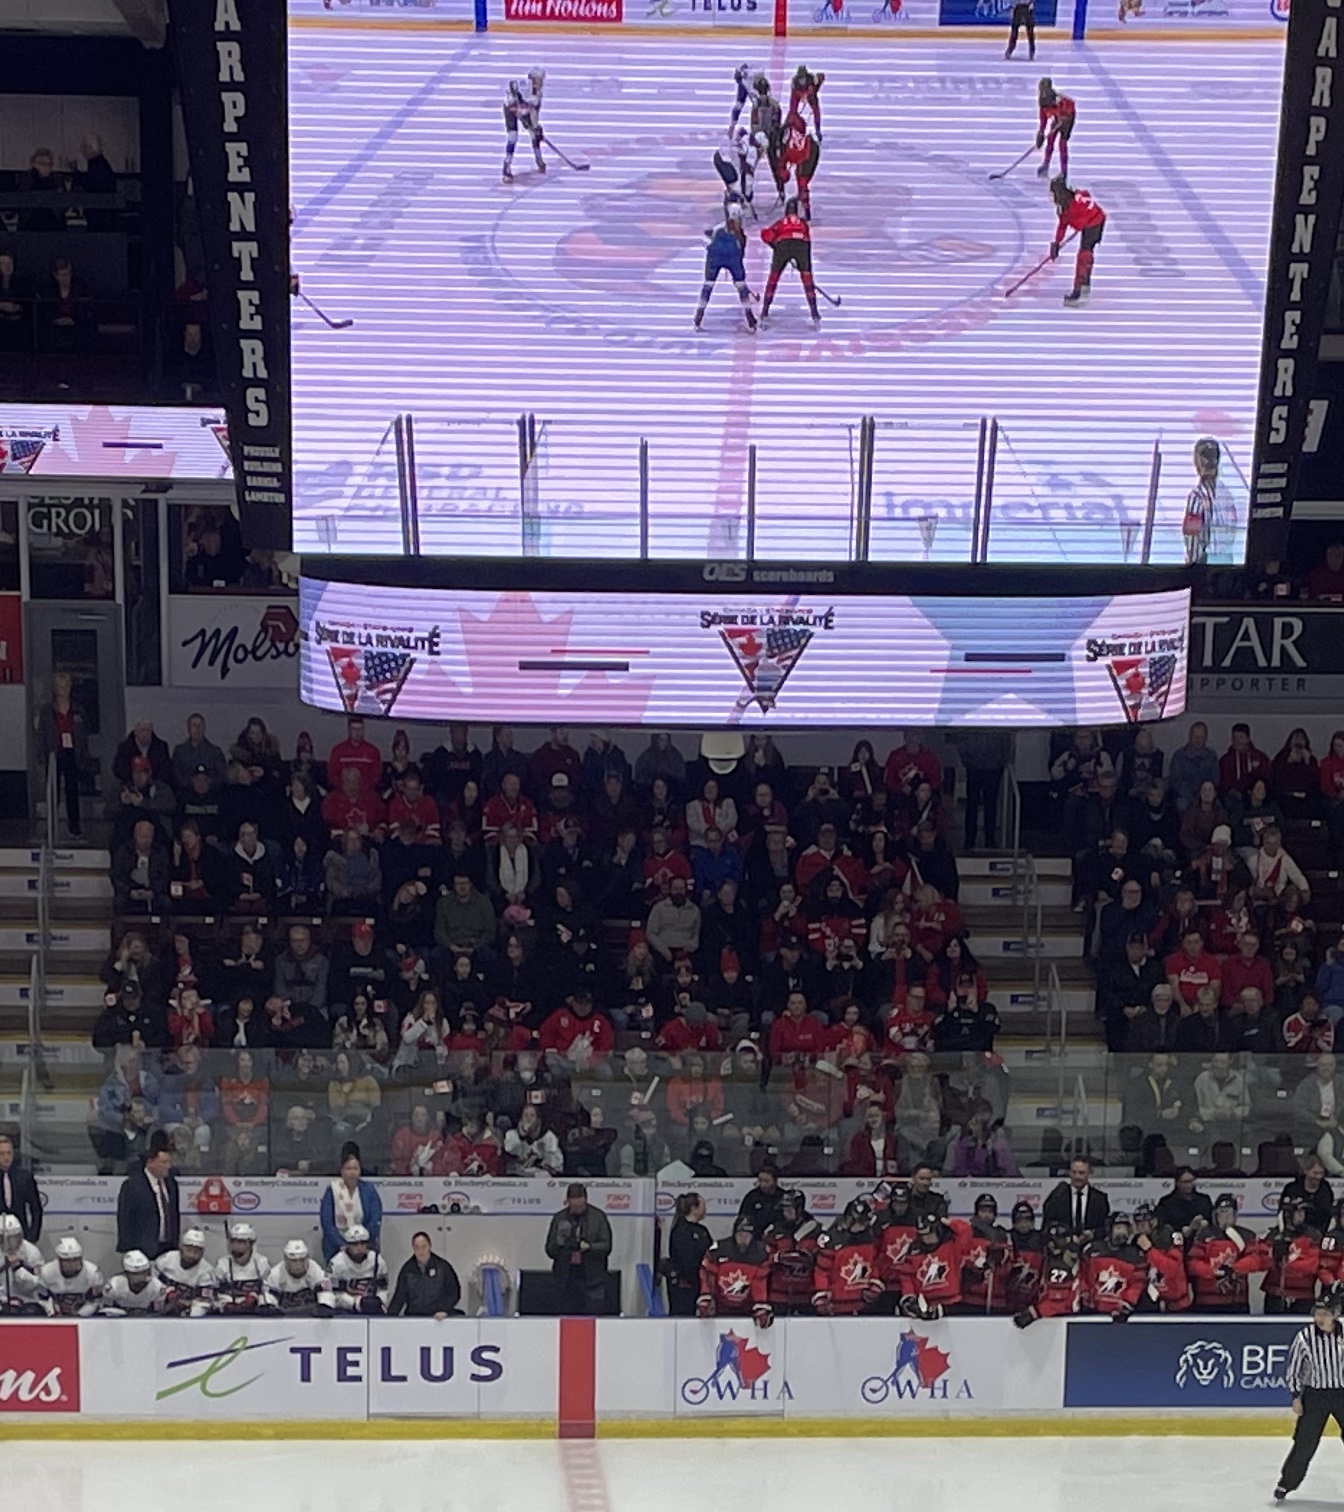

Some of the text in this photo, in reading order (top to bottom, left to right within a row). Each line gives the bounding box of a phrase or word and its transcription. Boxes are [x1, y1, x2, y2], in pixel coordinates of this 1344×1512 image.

[1268, 0, 1342, 444] ARPENTERS
[760, 614, 774, 626] LA
[1050, 1268, 1067, 1283] 27
[288, 1345, 504, 1383] TELUS
[1242, 1344, 1290, 1375] BF
